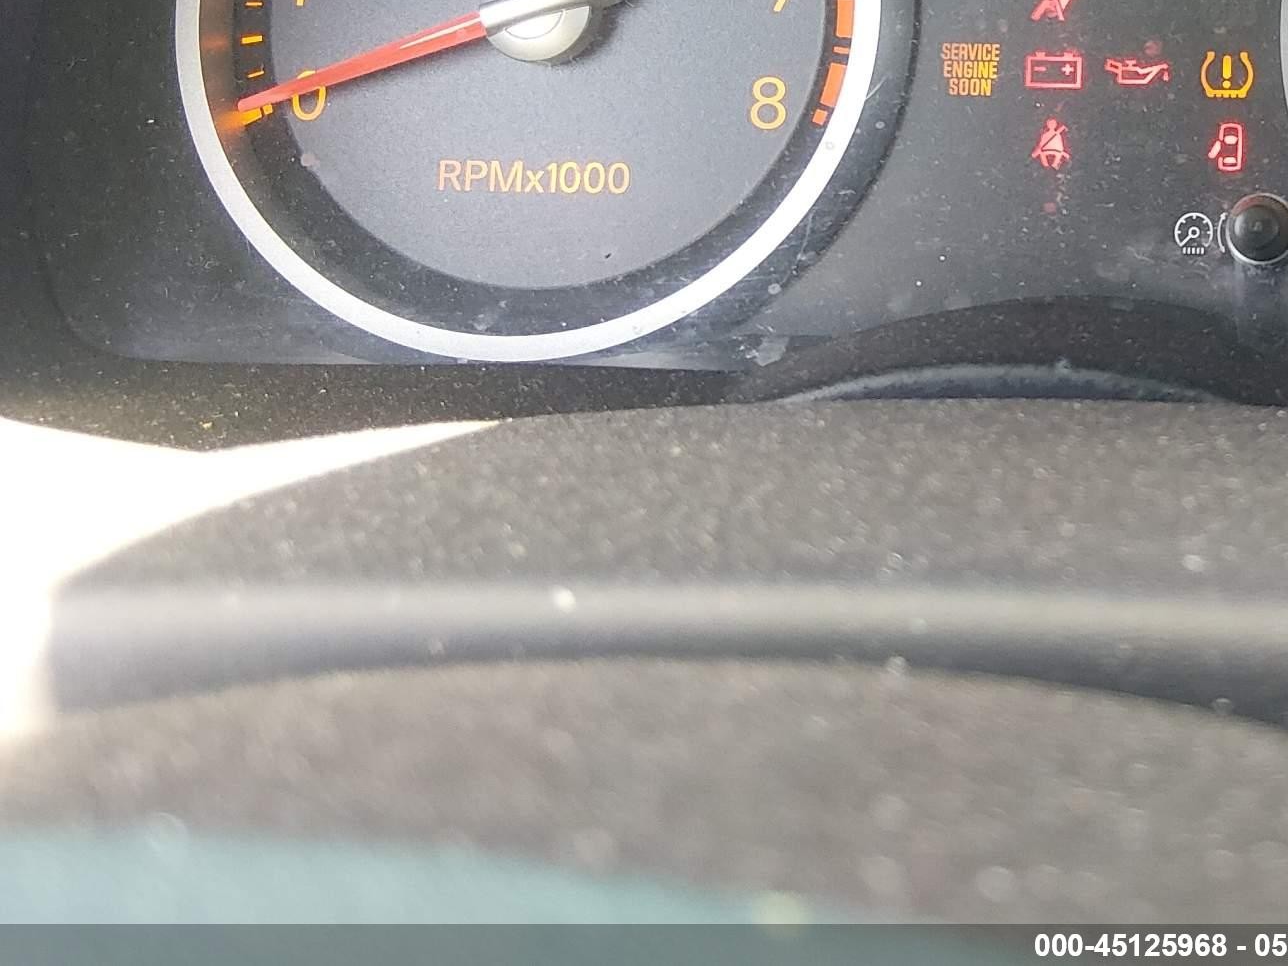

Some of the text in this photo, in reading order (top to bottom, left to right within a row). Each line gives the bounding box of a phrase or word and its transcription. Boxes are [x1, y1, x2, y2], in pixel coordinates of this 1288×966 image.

[941, 42, 1001, 61] SERVICE
[943, 61, 999, 79] ENGINE
[292, 70, 327, 122] 0
[948, 79, 993, 97] SOON
[750, 76, 787, 130] 8
[437, 160, 632, 195] RPMx1000
